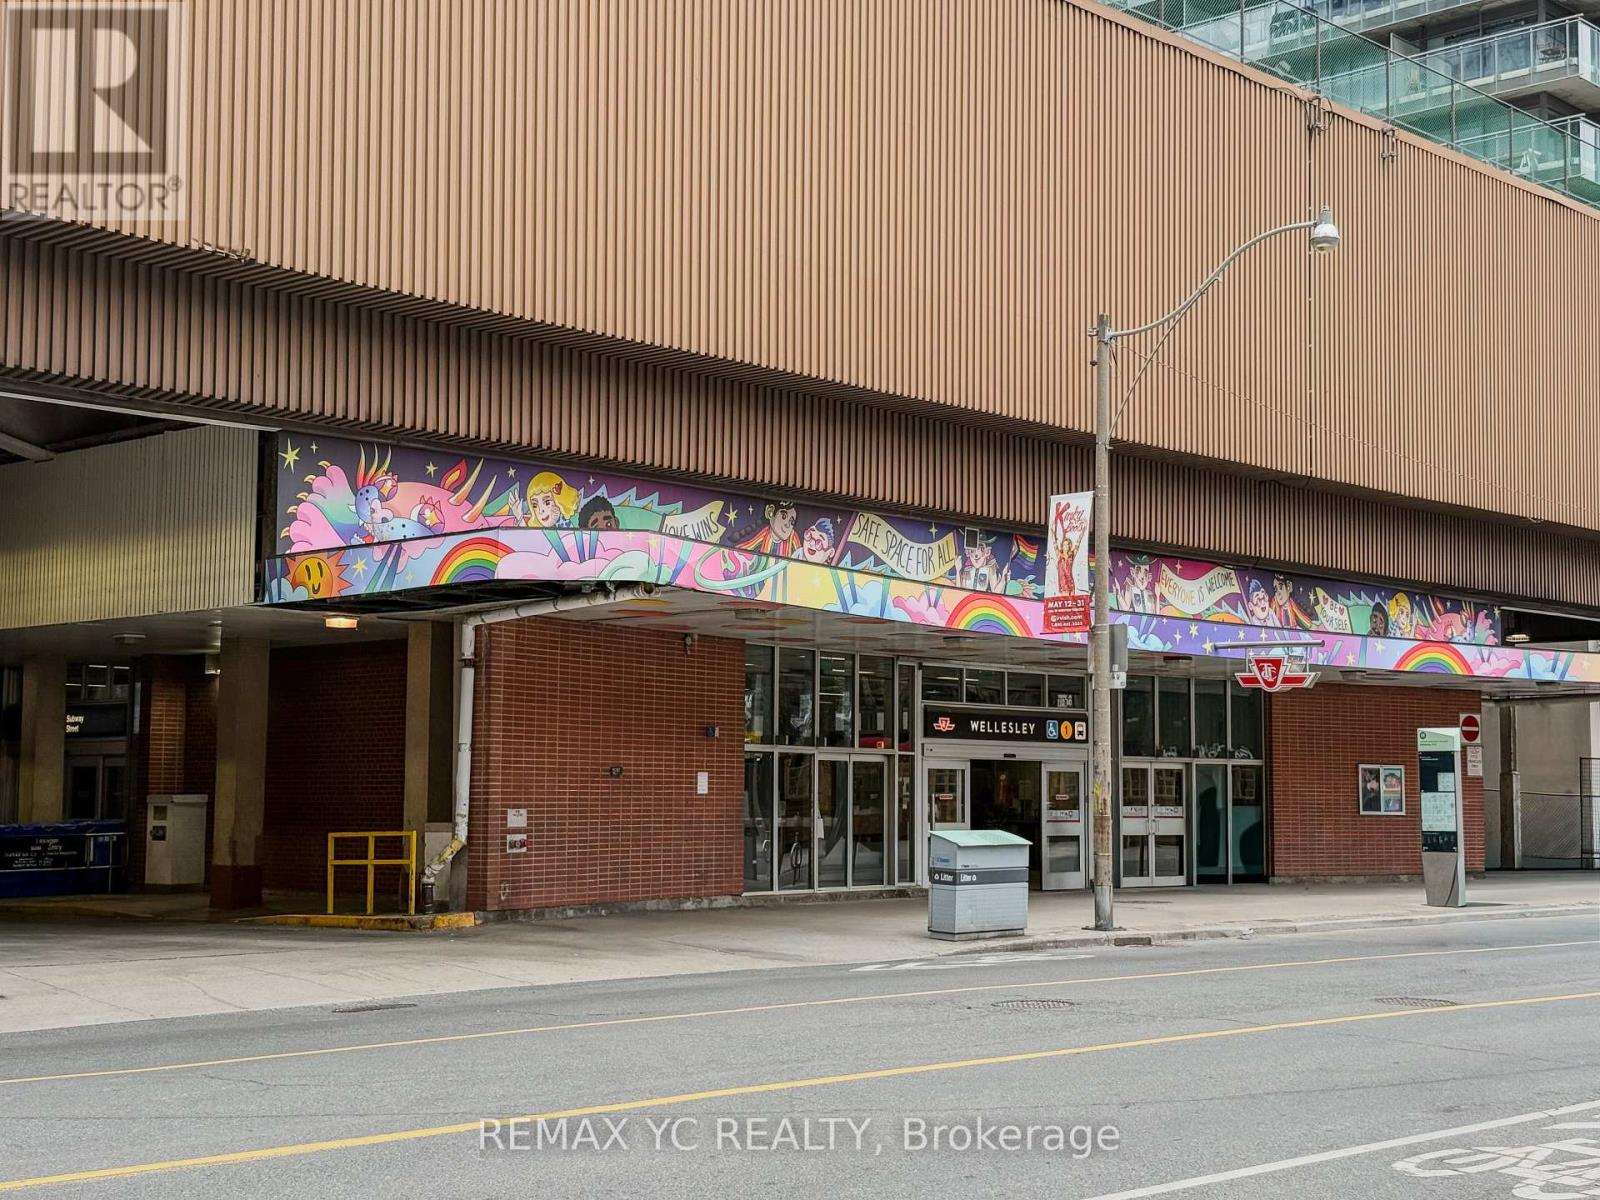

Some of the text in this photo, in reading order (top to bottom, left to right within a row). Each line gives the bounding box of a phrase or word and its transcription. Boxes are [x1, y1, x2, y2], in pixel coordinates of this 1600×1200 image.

[691, 511, 719, 540] WINS
[852, 513, 954, 576] SAFE SPACE FOR ALL
[1161, 569, 1235, 606] EVERYONE IS WELCOME
[1048, 600, 1063, 609] MAY
[66, 714, 84, 724] Subway
[970, 720, 1035, 734] WELLESLEY
[940, 873, 953, 881] Litter
[960, 873, 971, 881] Litter
